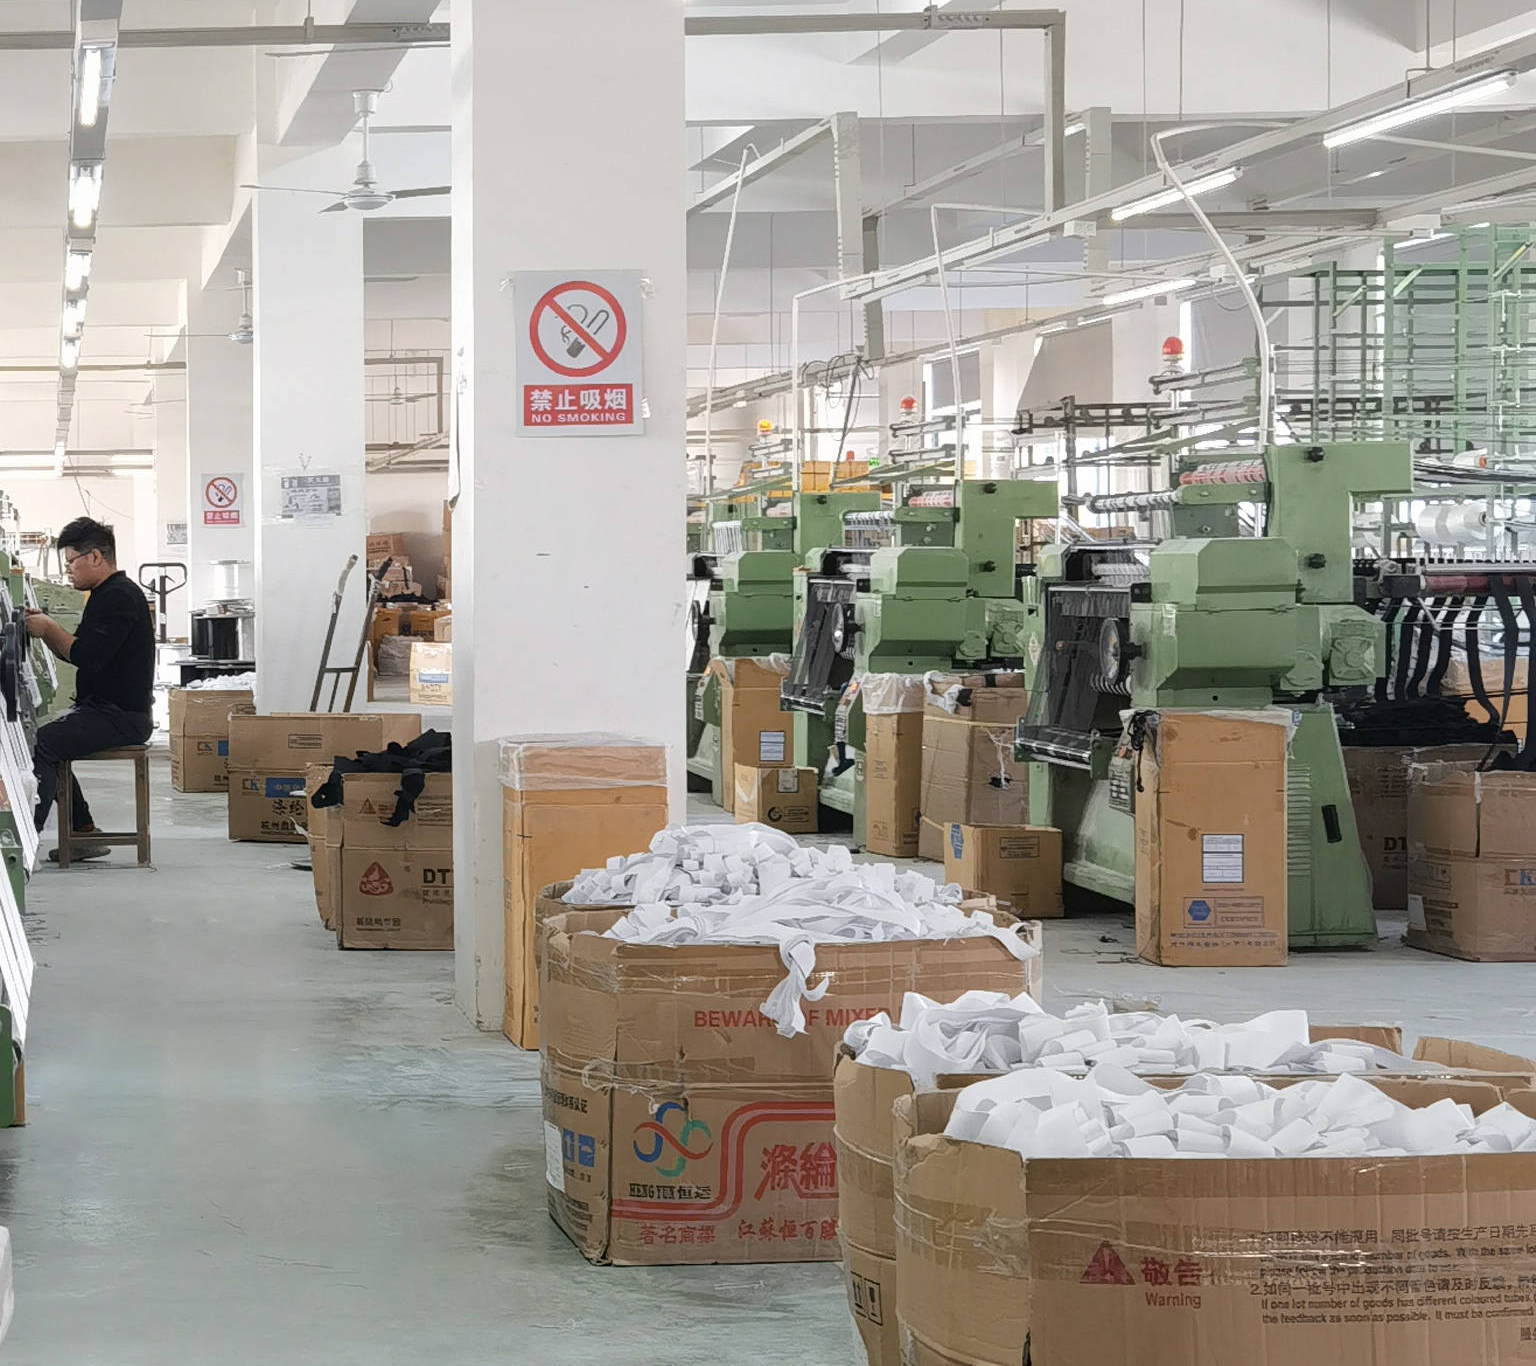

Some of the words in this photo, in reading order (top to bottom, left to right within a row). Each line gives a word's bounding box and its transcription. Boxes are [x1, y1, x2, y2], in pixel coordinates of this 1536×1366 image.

[530, 388, 626, 411] 禁止吸烟
[531, 414, 552, 423] NO
[558, 412, 626, 422] SMOKING
[423, 868, 453, 884] DT
[694, 1009, 776, 1028] BEWAR
[1140, 1256, 1203, 1286] 敬告
[1144, 1291, 1202, 1309] Warning
